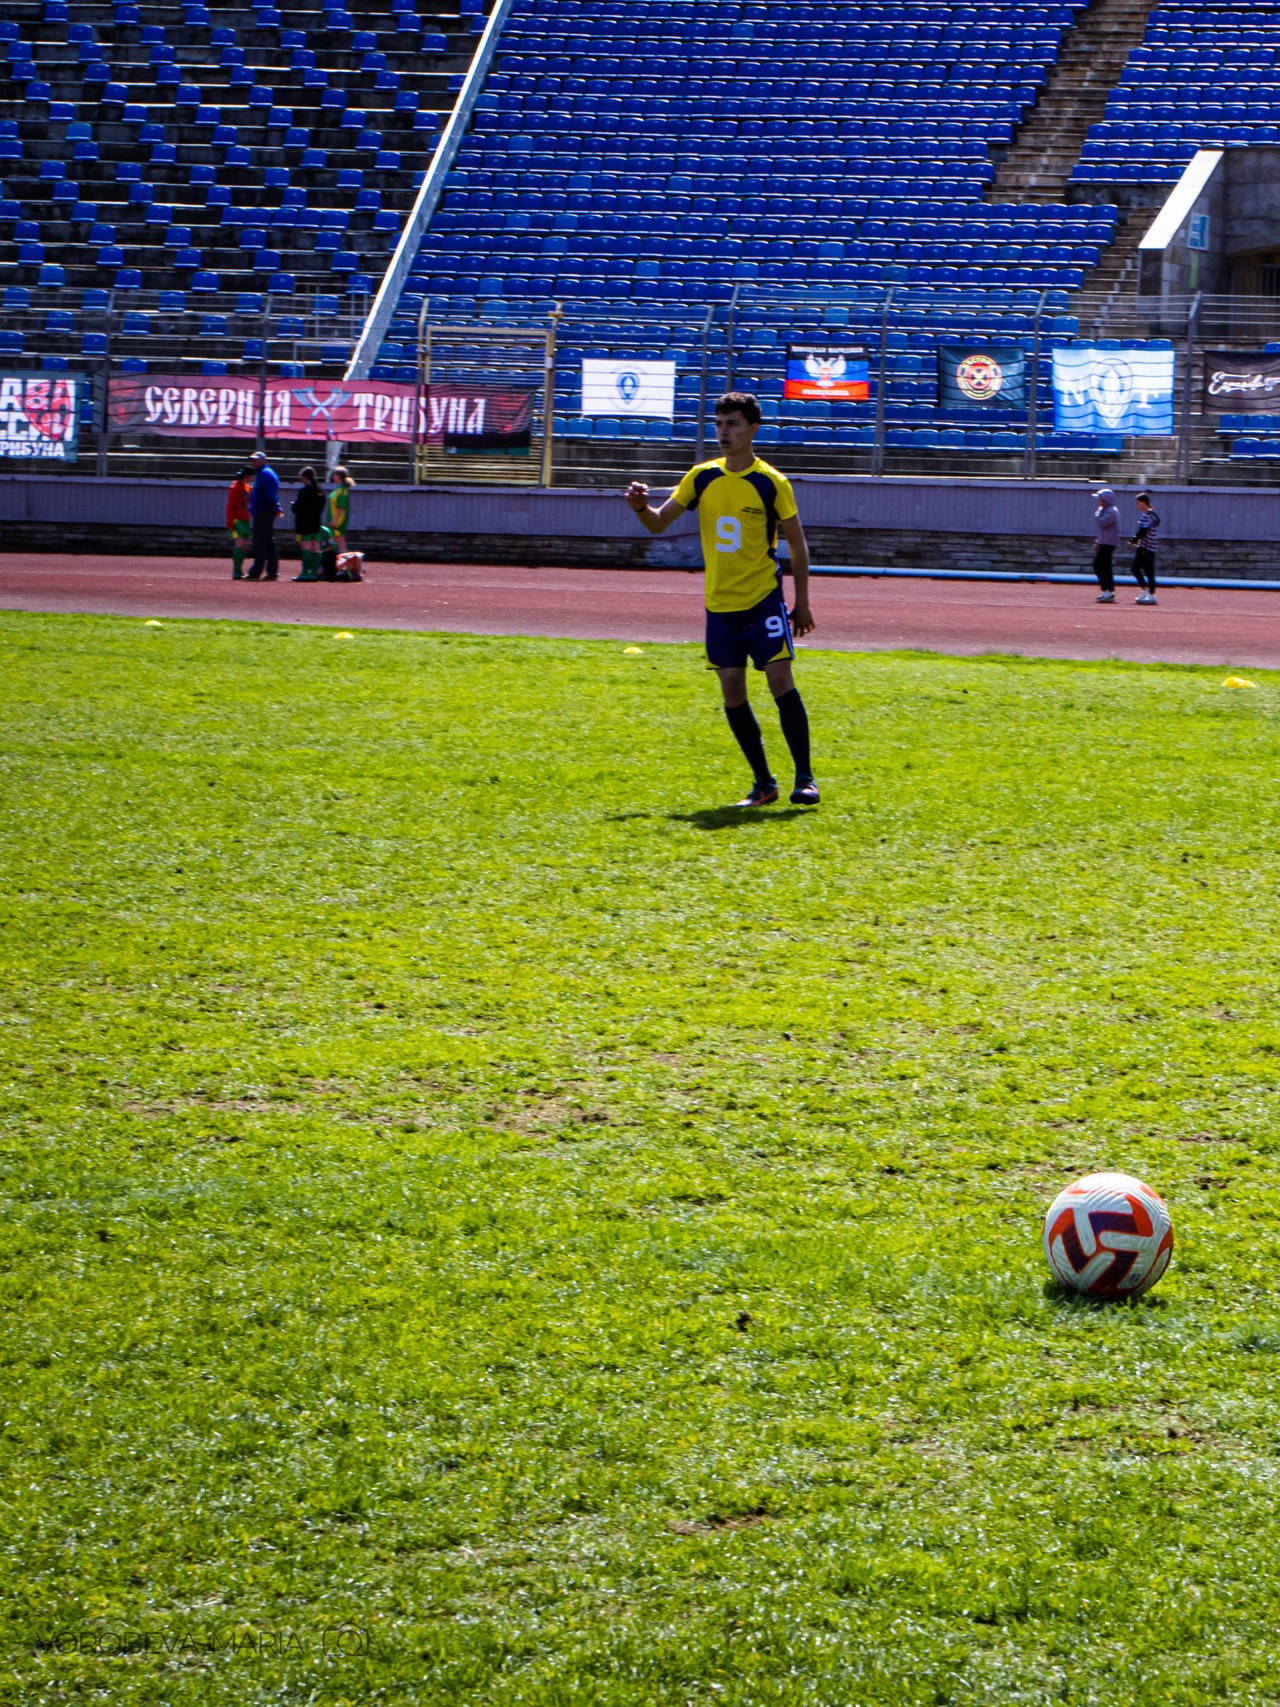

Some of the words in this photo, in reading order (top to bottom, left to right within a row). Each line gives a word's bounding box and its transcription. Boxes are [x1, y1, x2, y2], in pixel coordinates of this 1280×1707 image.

[352, 393, 487, 435] ТРИБУНА
[715, 515, 741, 553] 9
[765, 615, 784, 638] 9
